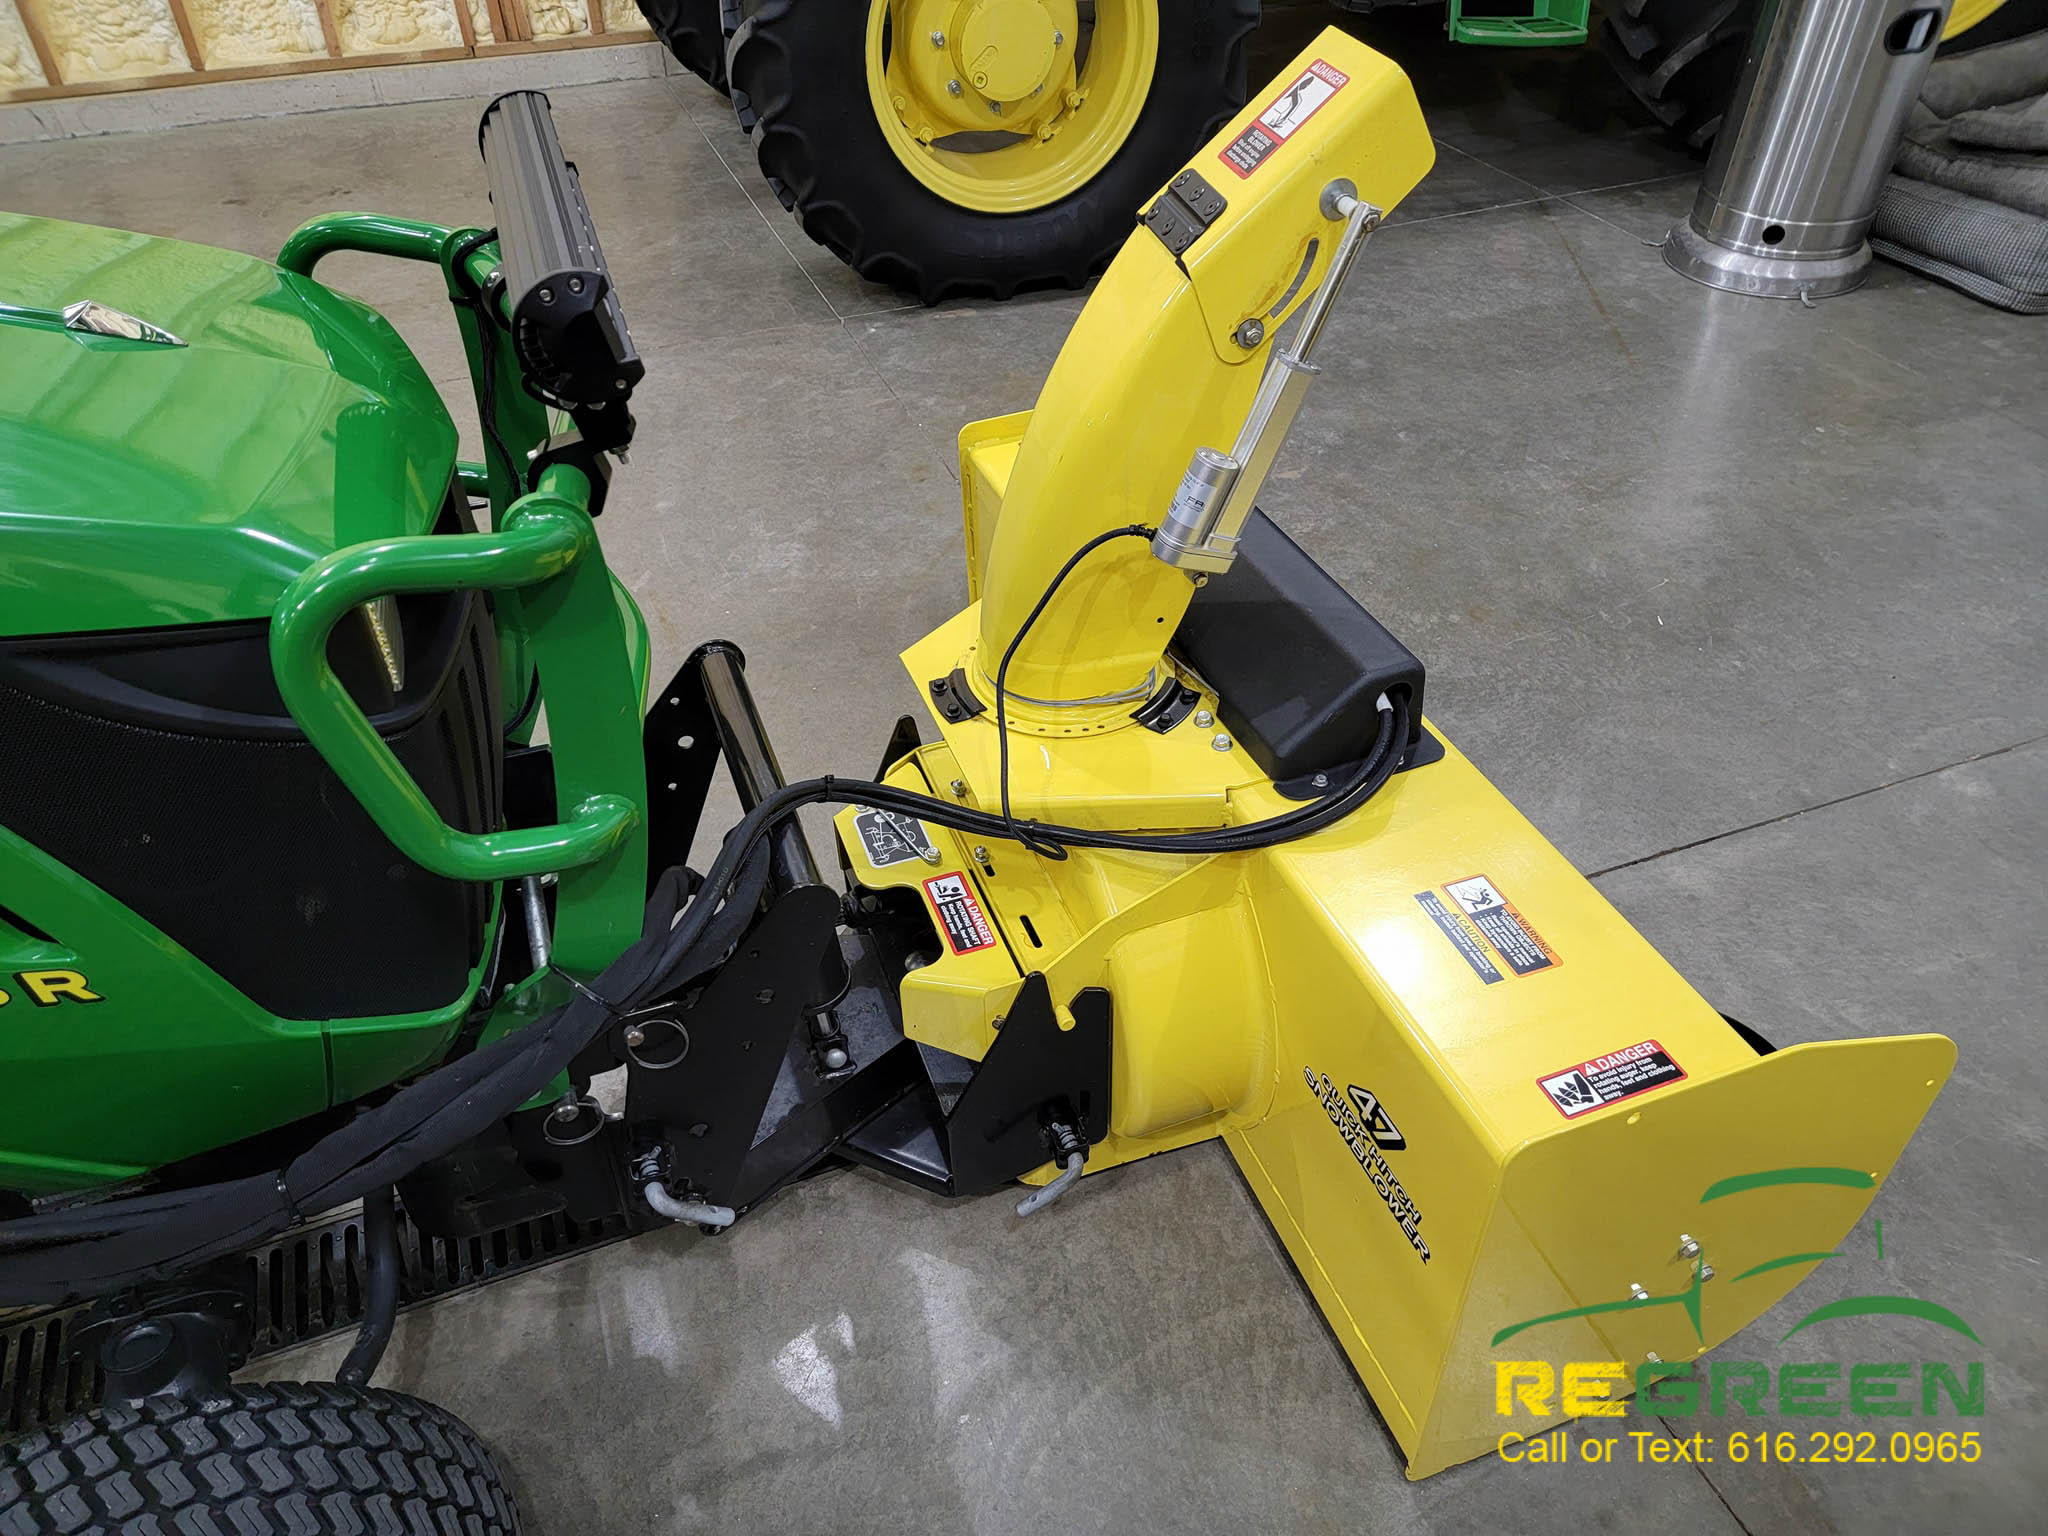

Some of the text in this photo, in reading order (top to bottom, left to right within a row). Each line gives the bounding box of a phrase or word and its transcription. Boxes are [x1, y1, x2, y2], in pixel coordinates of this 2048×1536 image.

[1315, 63, 1348, 87] DANGER
[955, 900, 980, 945] ROTATING SHAFT
[967, 905, 993, 944] DANGER
[1458, 919, 1490, 952] CAUTION
[1518, 920, 1552, 954] WARNING
[0, 969, 106, 1008] R
[1595, 1042, 1658, 1069] DANGER
[1597, 1069, 1617, 1078] avoid
[1634, 1056, 1653, 1066] from
[1592, 1075, 1620, 1088] rotating
[1639, 1062, 1658, 1072] keep
[1597, 1063, 1676, 1094] hands, feet and clothing
[1347, 1084, 1406, 1150] 47
[1303, 1065, 1430, 1264] SNOWBLOWER
[1320, 1072, 1422, 1226] QUICK HITCH
